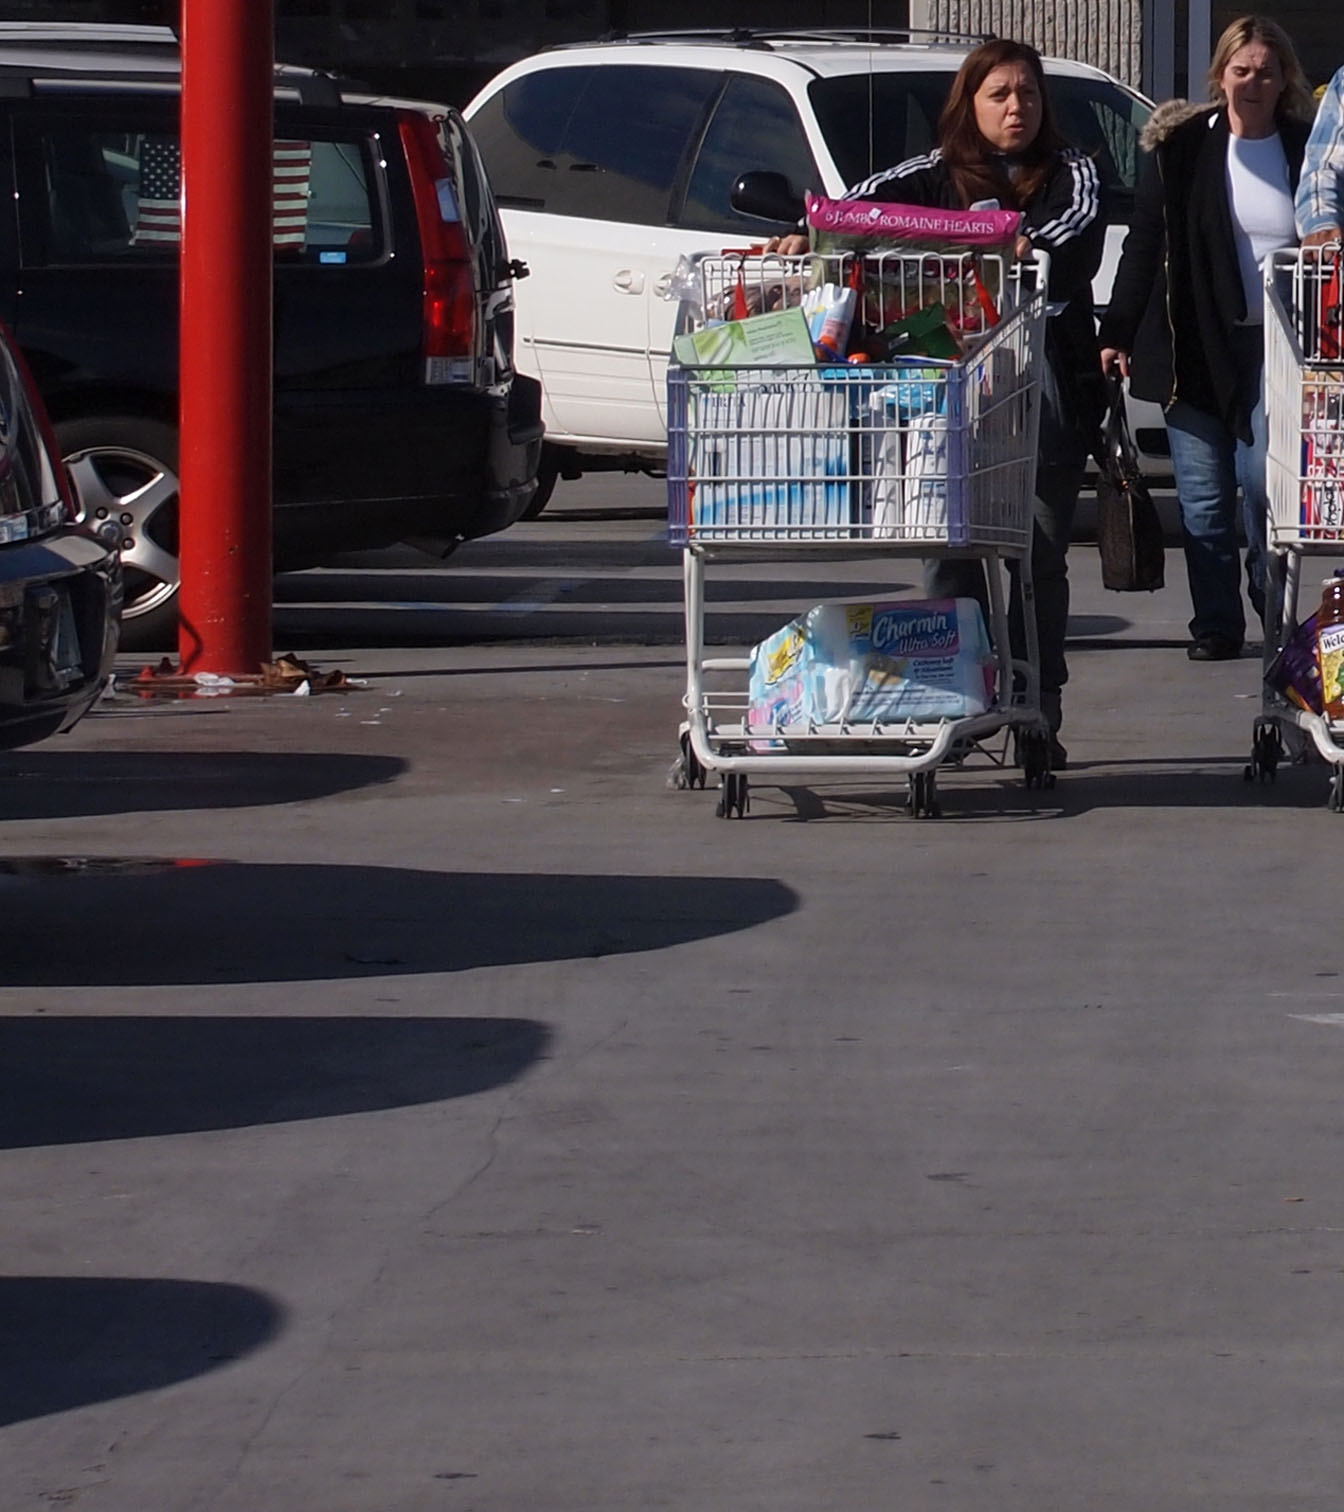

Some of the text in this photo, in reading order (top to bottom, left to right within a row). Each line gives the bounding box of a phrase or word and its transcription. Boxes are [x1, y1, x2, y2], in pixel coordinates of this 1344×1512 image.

[880, 215, 942, 231] ROMAINE
[944, 220, 995, 235] HEARTS
[872, 611, 948, 648] Charmin
[900, 629, 956, 655] Ultra Soft
